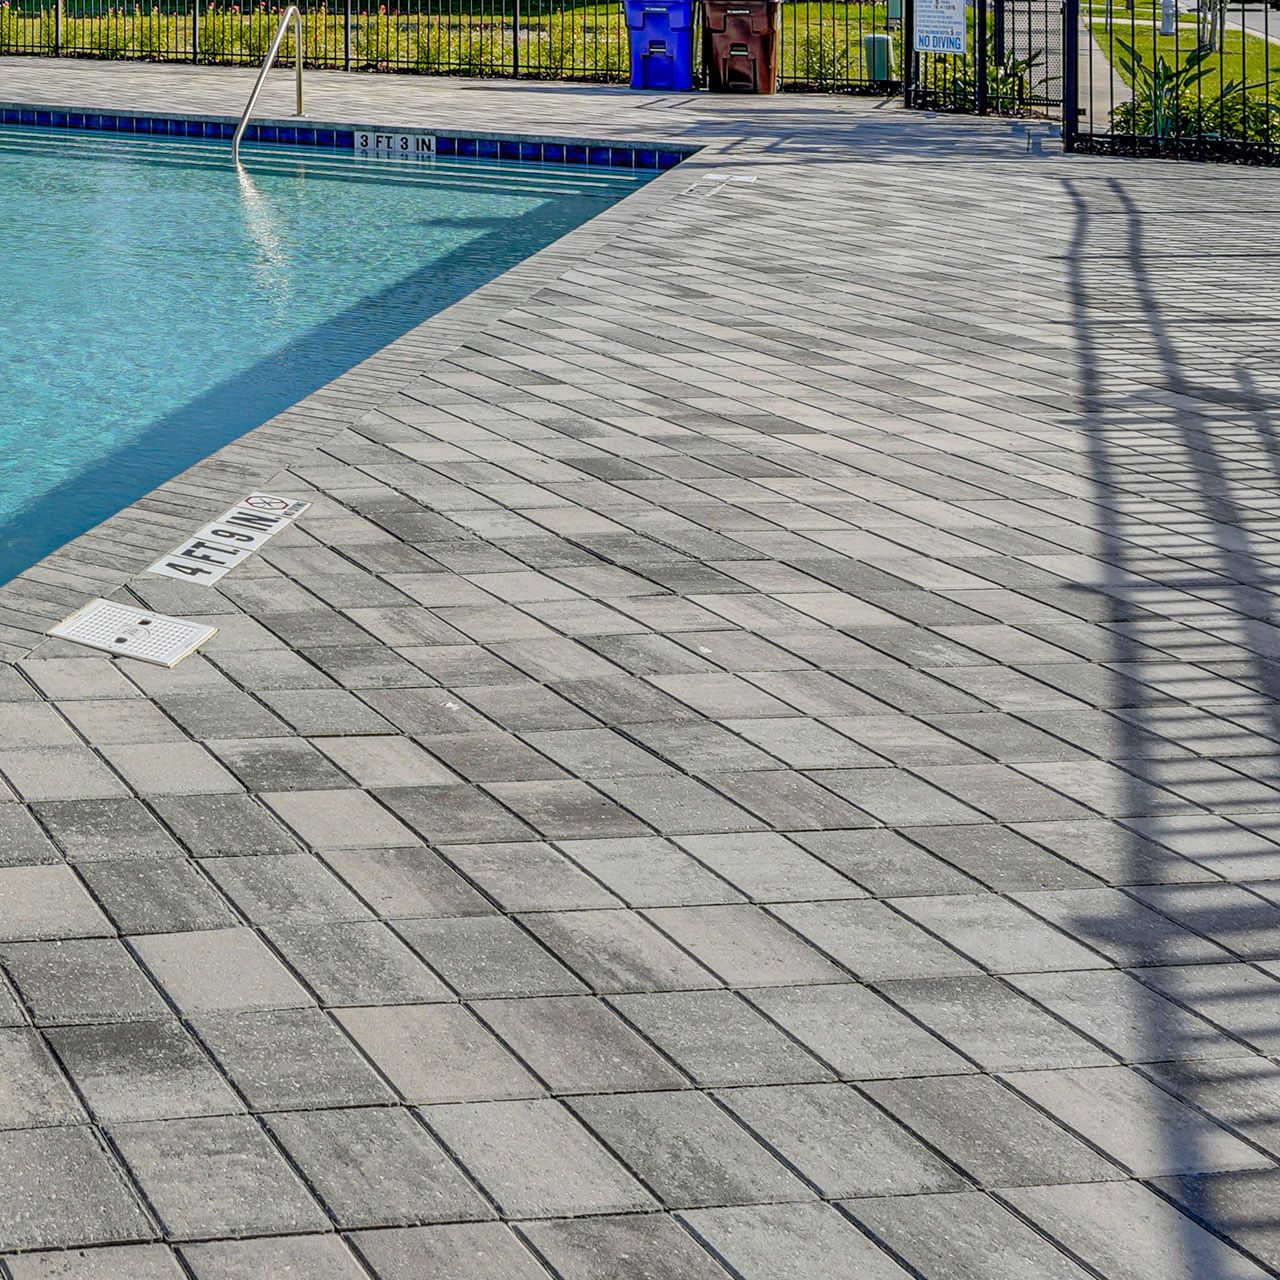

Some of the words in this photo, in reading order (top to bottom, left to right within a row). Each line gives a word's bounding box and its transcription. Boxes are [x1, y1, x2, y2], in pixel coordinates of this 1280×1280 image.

[918, 35, 930, 48] NO
[932, 35, 961, 50] DIVING
[360, 134, 368, 148] 3
[376, 135, 393, 150] FT.
[400, 137, 408, 151] 3
[416, 138, 435, 152] IN.
[225, 510, 282, 532] IN.
[211, 529, 255, 543] 9
[182, 541, 240, 565] FT.
[165, 562, 212, 577] 4
